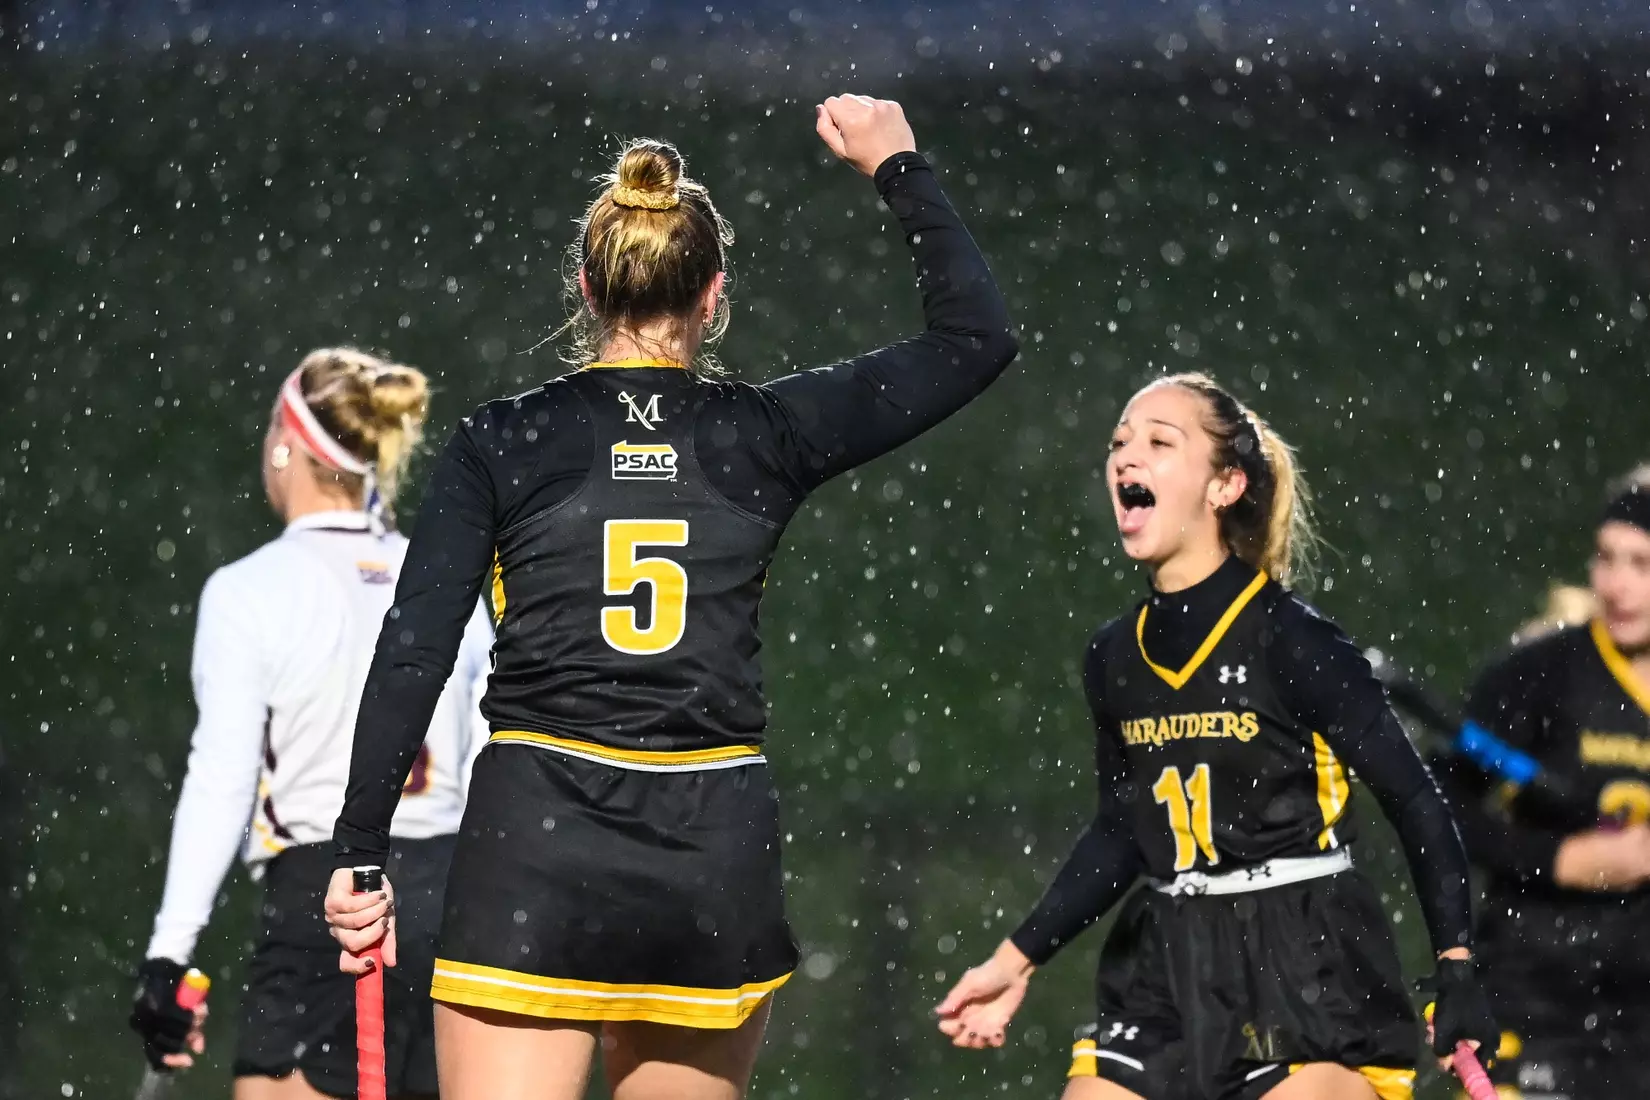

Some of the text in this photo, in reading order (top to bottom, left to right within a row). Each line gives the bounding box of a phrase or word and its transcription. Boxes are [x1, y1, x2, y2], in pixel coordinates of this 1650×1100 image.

[618, 390, 664, 431] M
[613, 454, 674, 469] PSAC
[600, 519, 690, 656] 5
[1121, 711, 1260, 746] MARAUDERS
[1152, 763, 1220, 872] 11
